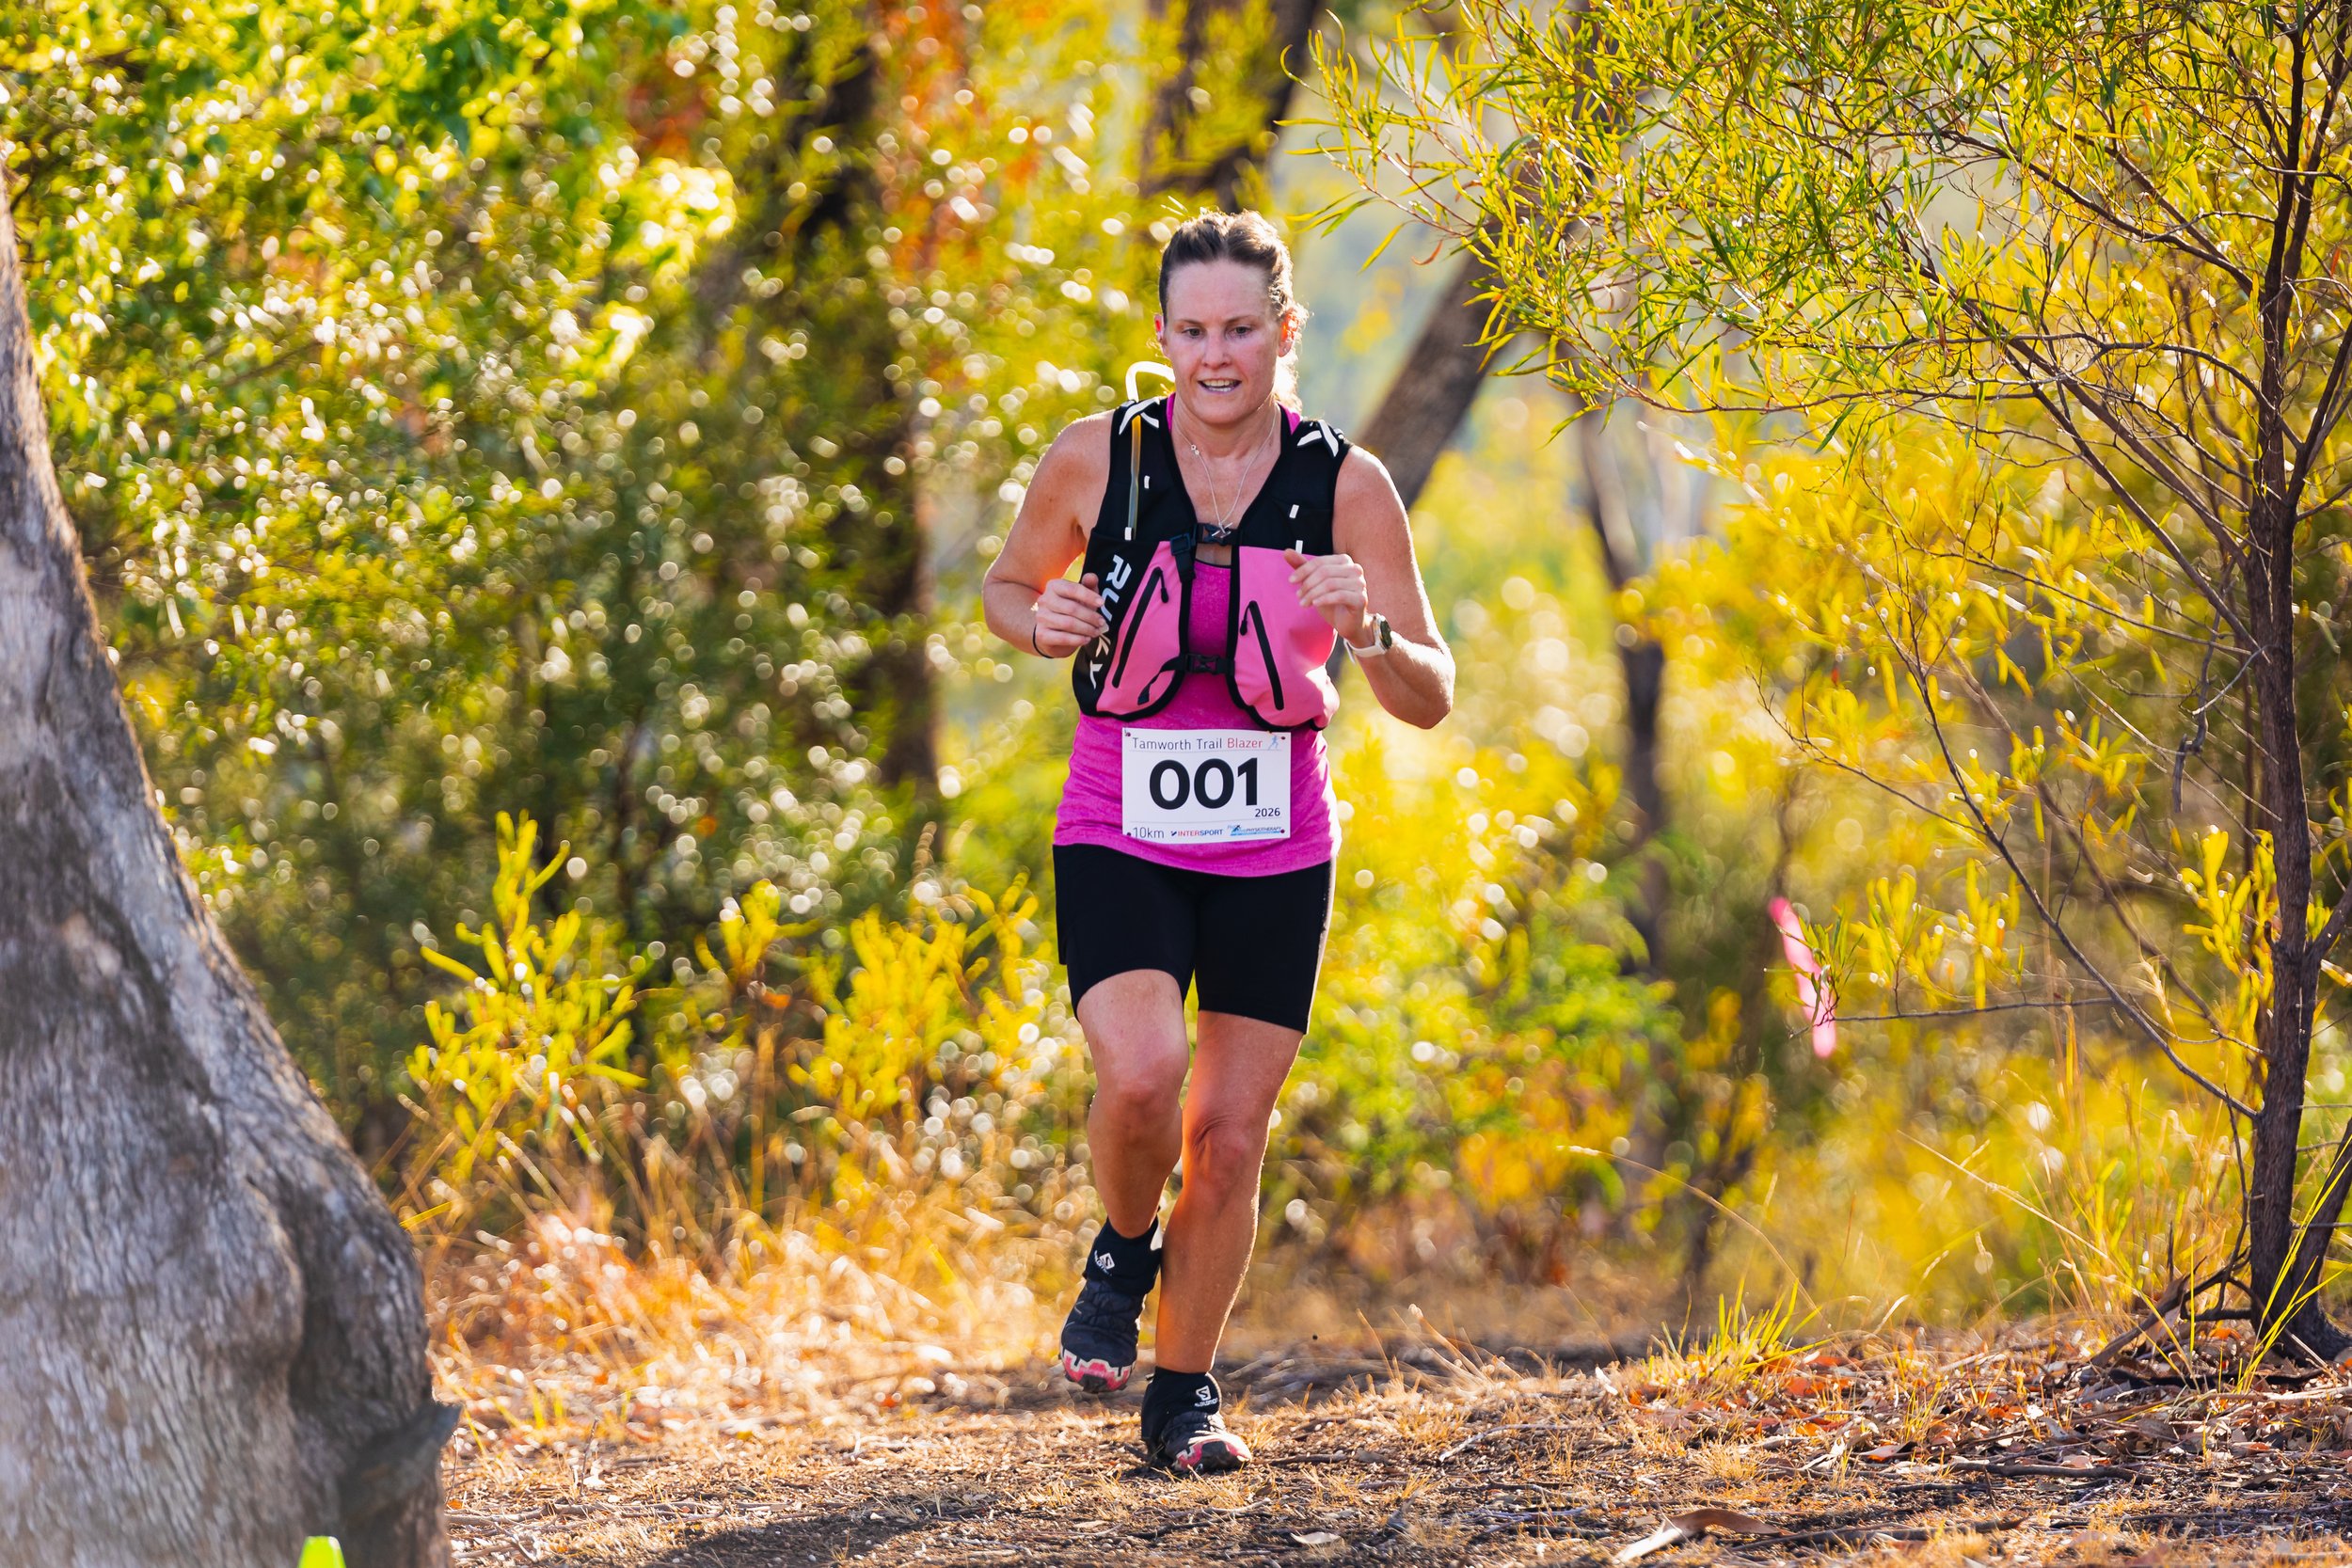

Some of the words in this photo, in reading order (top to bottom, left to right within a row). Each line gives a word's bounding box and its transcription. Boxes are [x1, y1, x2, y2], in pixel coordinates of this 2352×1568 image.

[1089, 554, 1133, 689] RUKY
[1132, 737, 1192, 751] Tamworth
[1196, 737, 1222, 750] Trail
[1227, 737, 1263, 749] Blazer
[1149, 757, 1258, 810] 001
[1254, 807, 1280, 817] 2026
[1133, 827, 1165, 839] 10km
